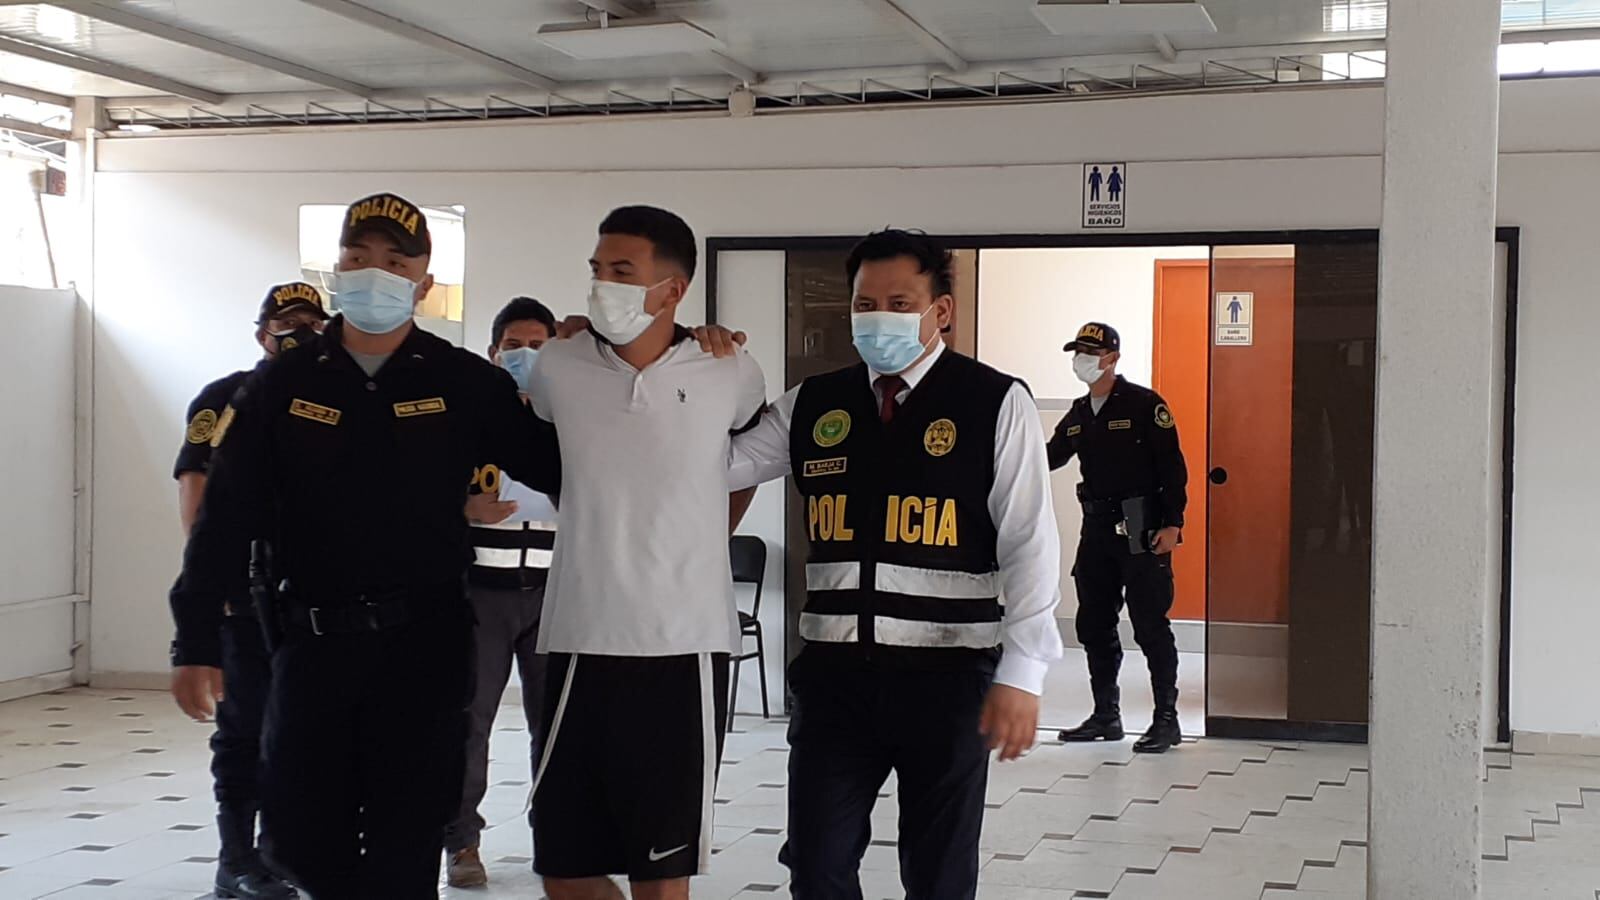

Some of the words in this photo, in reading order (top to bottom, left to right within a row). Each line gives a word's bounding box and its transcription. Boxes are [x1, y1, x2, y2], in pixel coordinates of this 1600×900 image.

[350, 196, 418, 236] POLICIA
[1088, 216, 1121, 225] BAÑO
[273, 284, 319, 306] POLICIA
[1077, 325, 1104, 341] LICIA
[809, 494, 854, 542] POL
